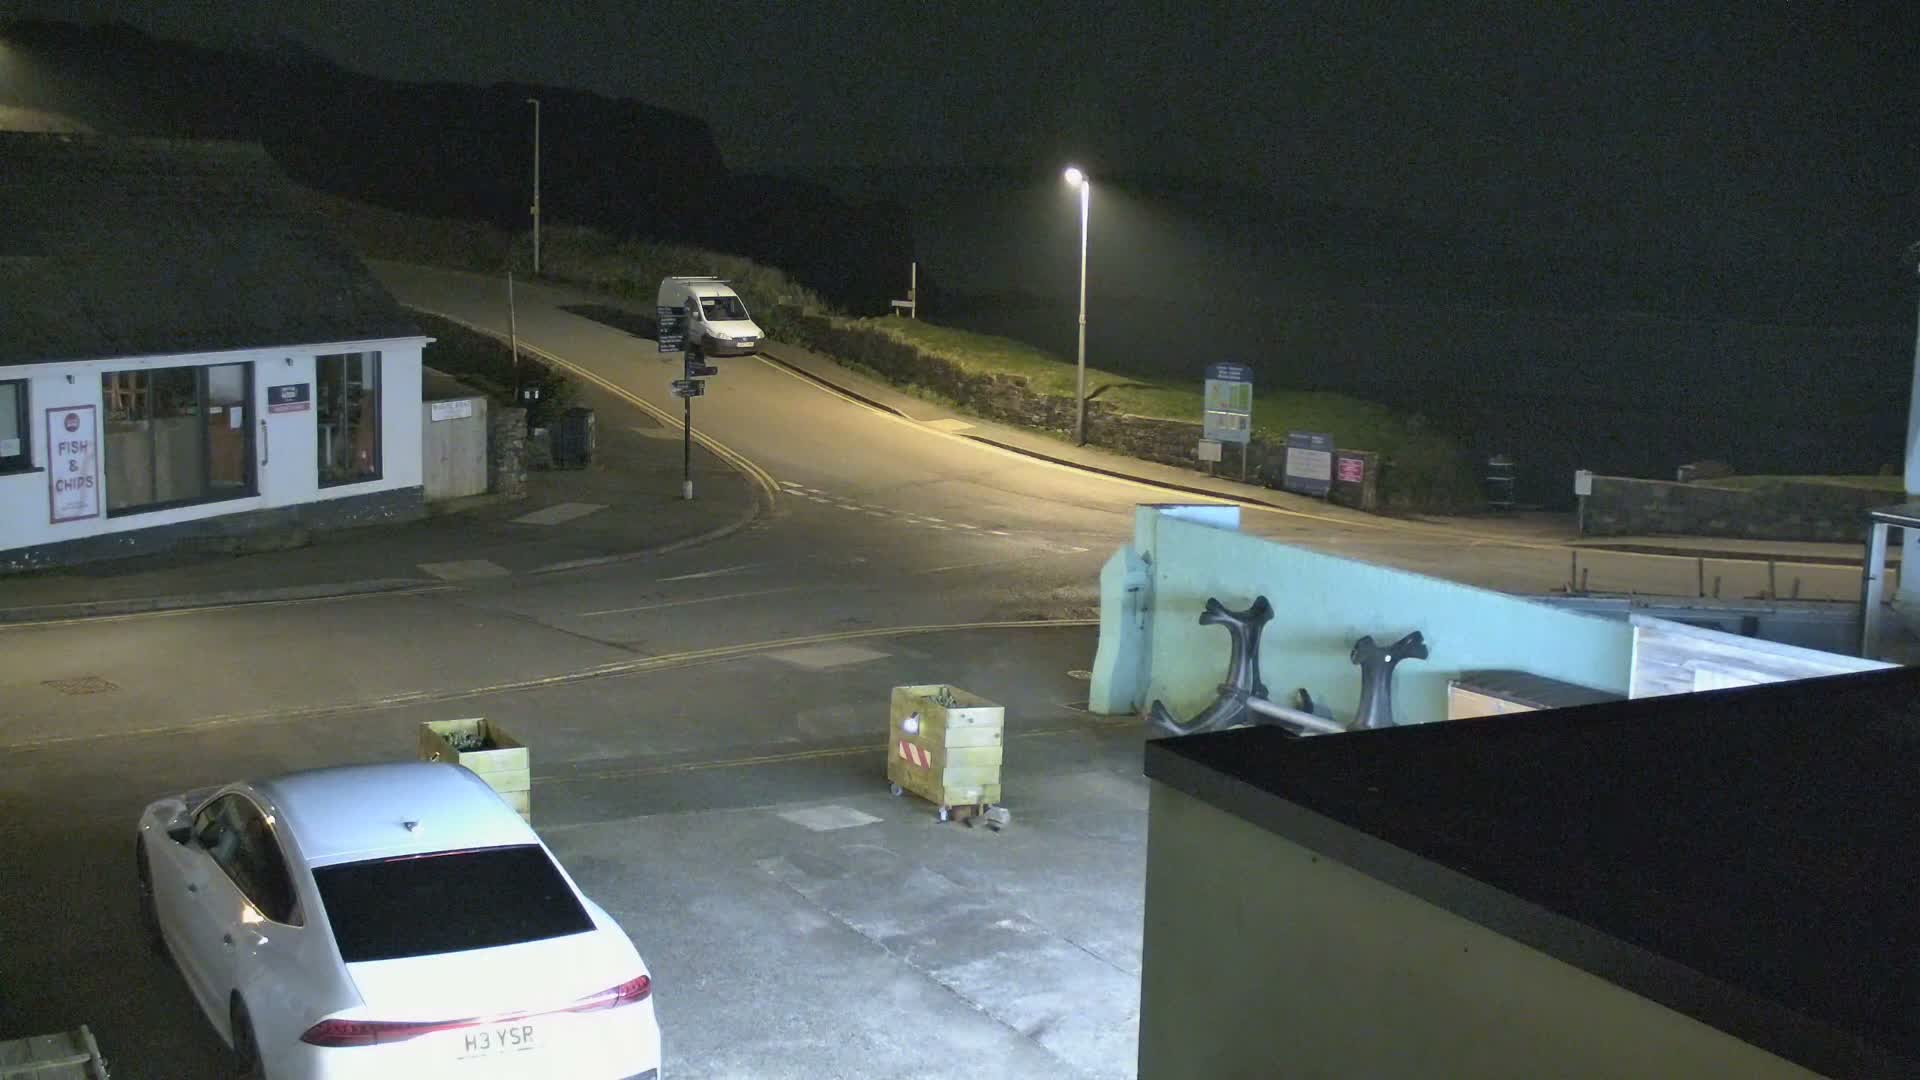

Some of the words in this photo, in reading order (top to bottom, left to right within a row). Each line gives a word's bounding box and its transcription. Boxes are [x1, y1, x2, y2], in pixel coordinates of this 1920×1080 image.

[58, 440, 88, 456] FISH
[68, 459, 79, 473] &
[55, 476, 94, 493] CHIPS
[465, 1032, 491, 1052] H3
